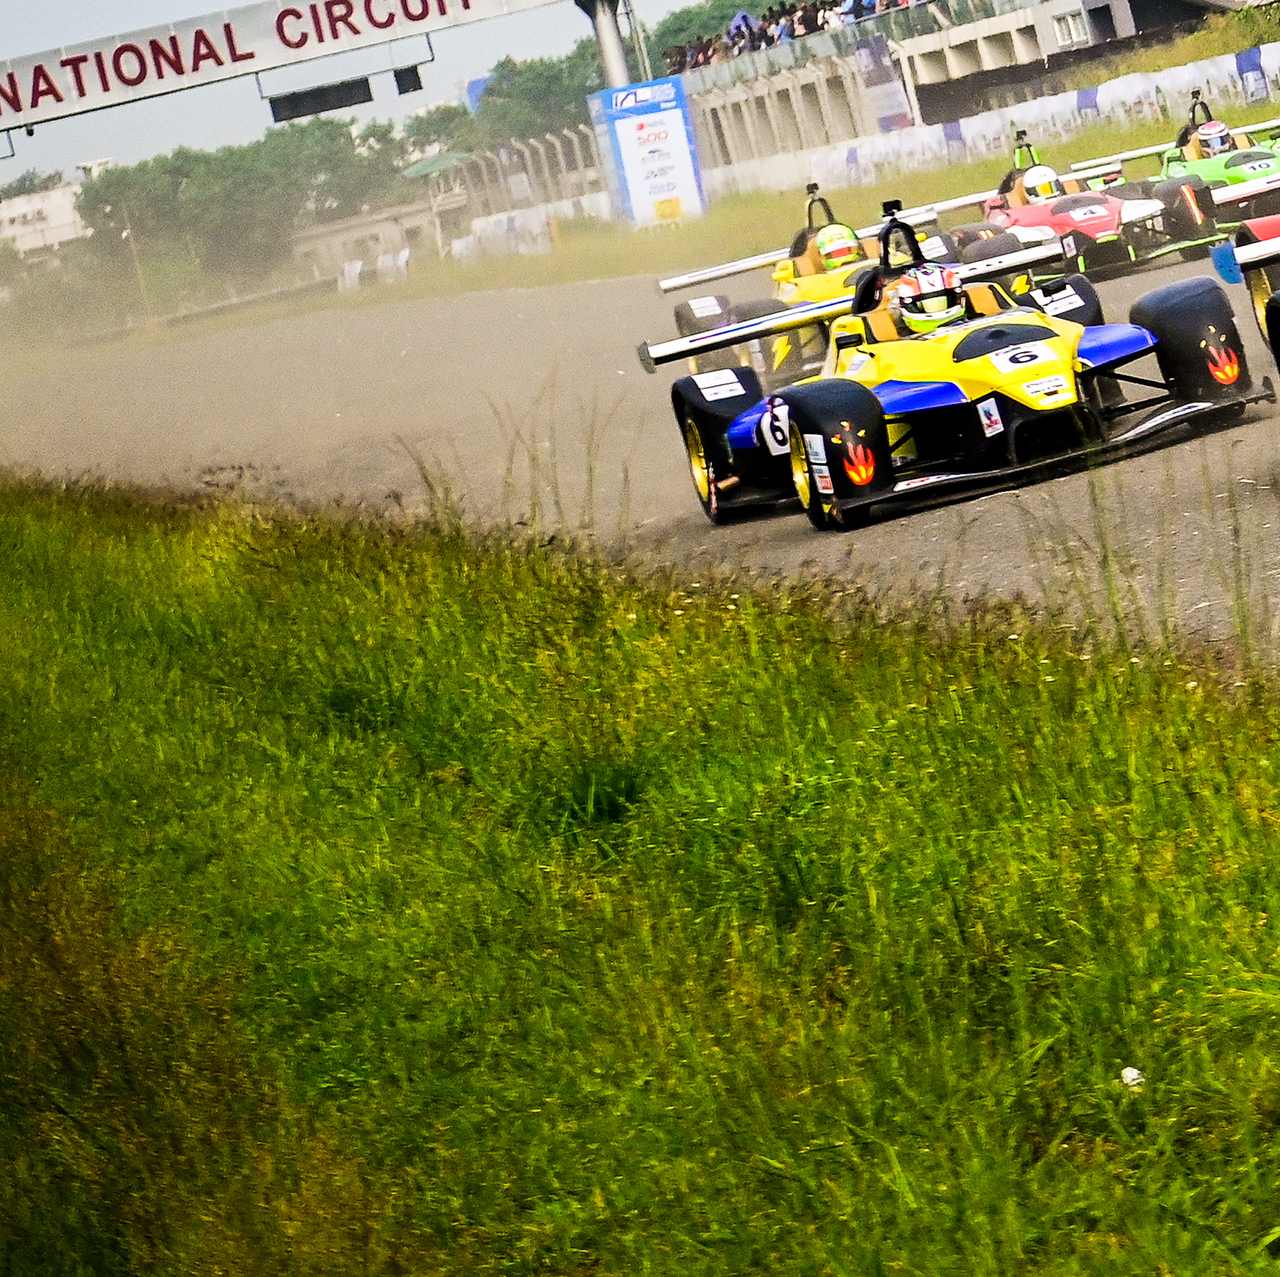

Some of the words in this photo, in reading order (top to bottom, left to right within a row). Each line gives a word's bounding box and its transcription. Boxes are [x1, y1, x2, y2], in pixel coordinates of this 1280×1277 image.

[1248, 162, 1271, 172] 10
[1009, 351, 1038, 364] 6
[770, 413, 788, 447] 6
